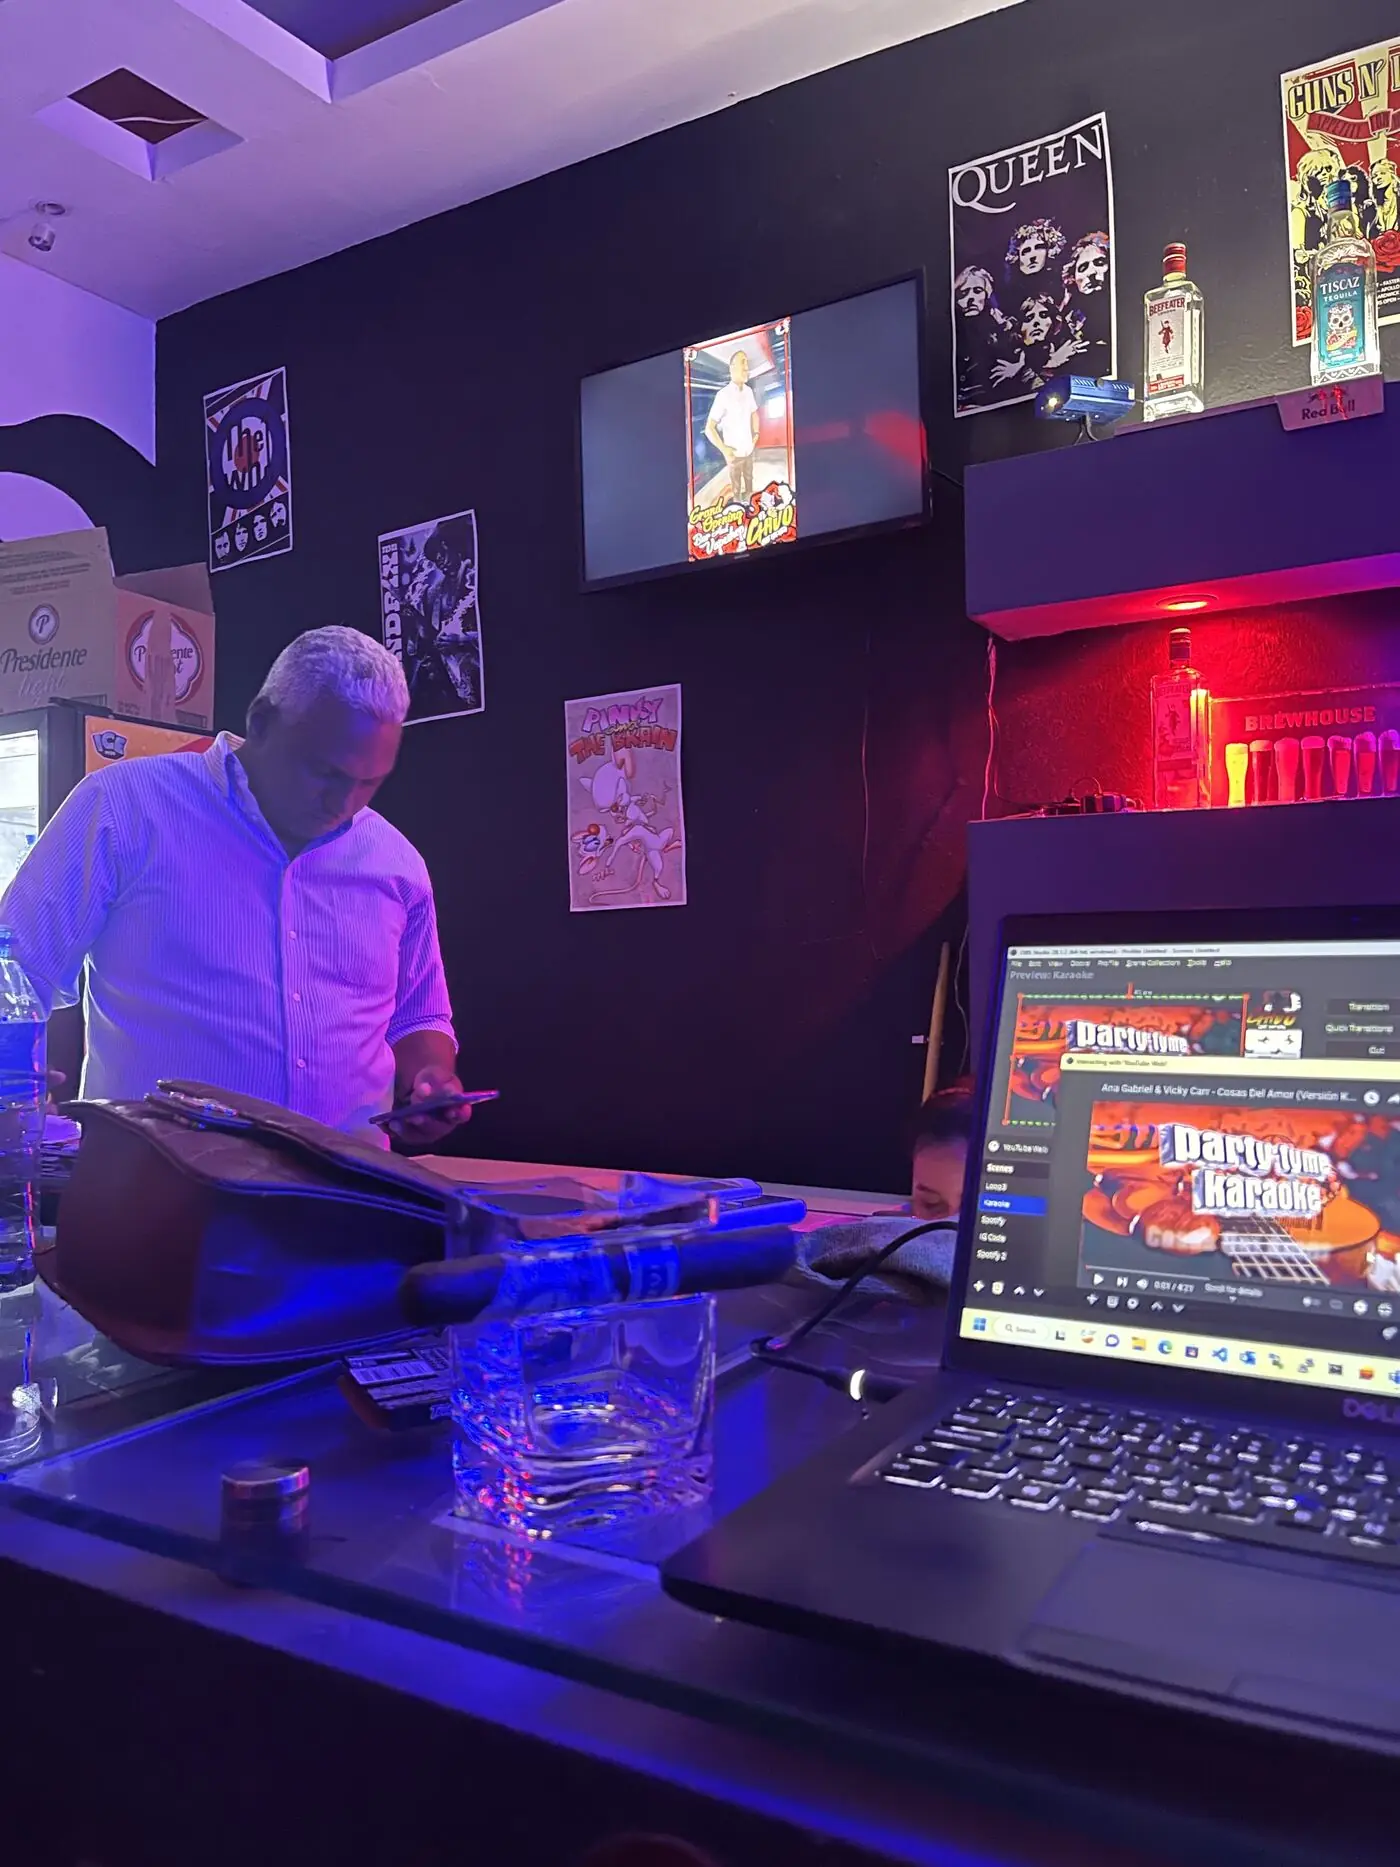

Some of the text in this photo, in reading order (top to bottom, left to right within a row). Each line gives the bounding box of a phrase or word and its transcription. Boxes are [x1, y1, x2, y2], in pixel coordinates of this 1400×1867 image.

[1288, 69, 1354, 120] GUNS
[952, 123, 1103, 214] QUEEN
[1320, 276, 1360, 295] TISCAZ
[1324, 290, 1358, 302] TEQUILA
[1149, 297, 1185, 317] BEEFEATER
[1302, 402, 1327, 421] Red
[690, 496, 724, 526] Grand
[702, 509, 744, 533] Opening
[36, 613, 50, 634] P
[0, 647, 87, 674] Presidente
[133, 644, 194, 663] Pente
[582, 696, 664, 733] PINKY
[1244, 706, 1376, 731] BREWHOUSE
[569, 725, 678, 764] THE BRAIN
[1010, 970, 1095, 980] Preview: Karaoke
[1101, 1083, 1119, 1093] Ana
[1121, 1083, 1153, 1094] Gabriel
[1154, 1085, 1162, 1095] &
[1163, 1085, 1188, 1097] Vicky
[1190, 1086, 1210, 1096] Carr
[1217, 1087, 1247, 1097] Cosas
[1249, 1088, 1265, 1098] Del
[1267, 1089, 1293, 1099] Amor
[986, 1162, 1014, 1174] Scenes
[983, 1199, 1011, 1209] Karaoke
[981, 1215, 1007, 1228] Spotify
[976, 1249, 1000, 1262] Spotify
